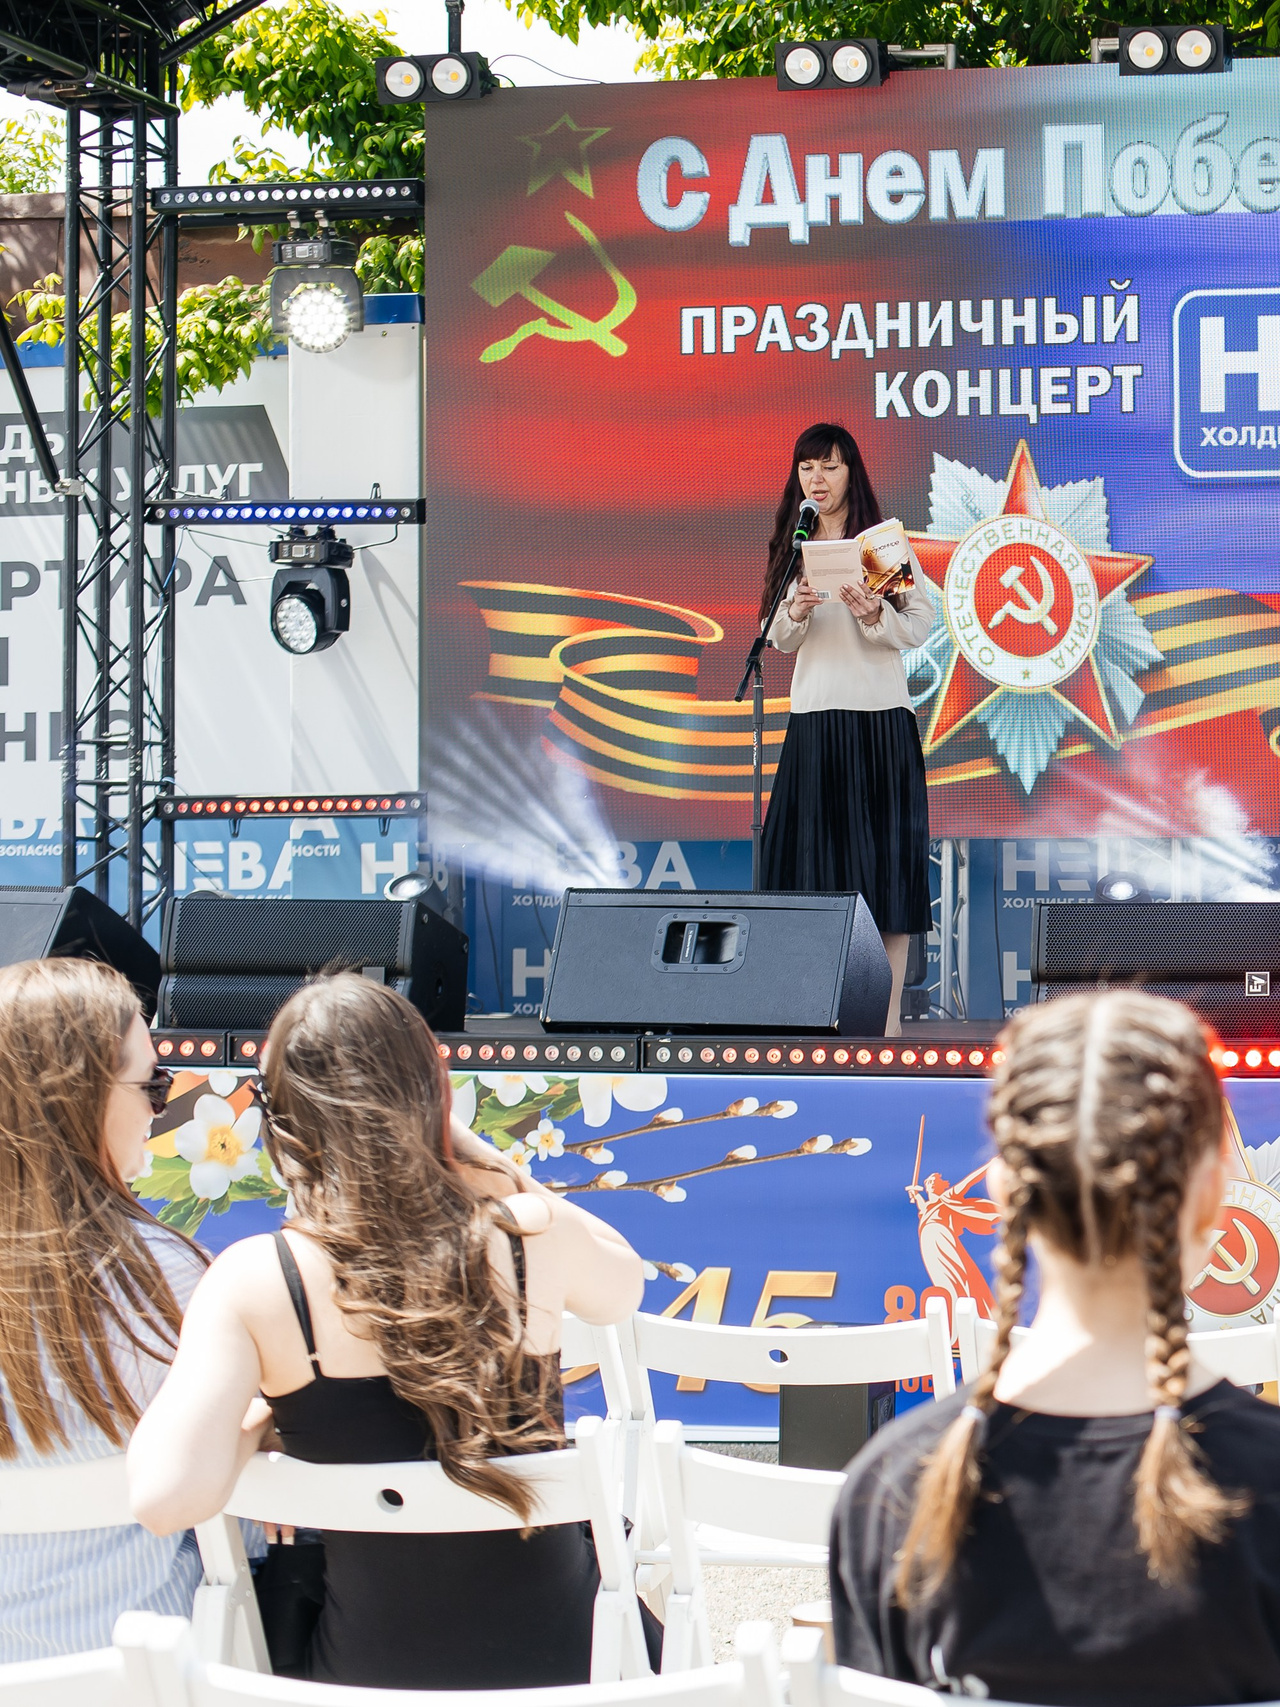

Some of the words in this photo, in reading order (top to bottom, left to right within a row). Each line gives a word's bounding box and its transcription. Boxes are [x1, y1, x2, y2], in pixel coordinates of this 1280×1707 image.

[728, 133, 1006, 247] Днем
[679, 278, 1140, 360] ПРАЗДНИЧНЫЙ
[874, 363, 1143, 425] КОНЦЕРТ
[954, 521, 1080, 666] ОТЕЧЕСТВЕННАЯ
